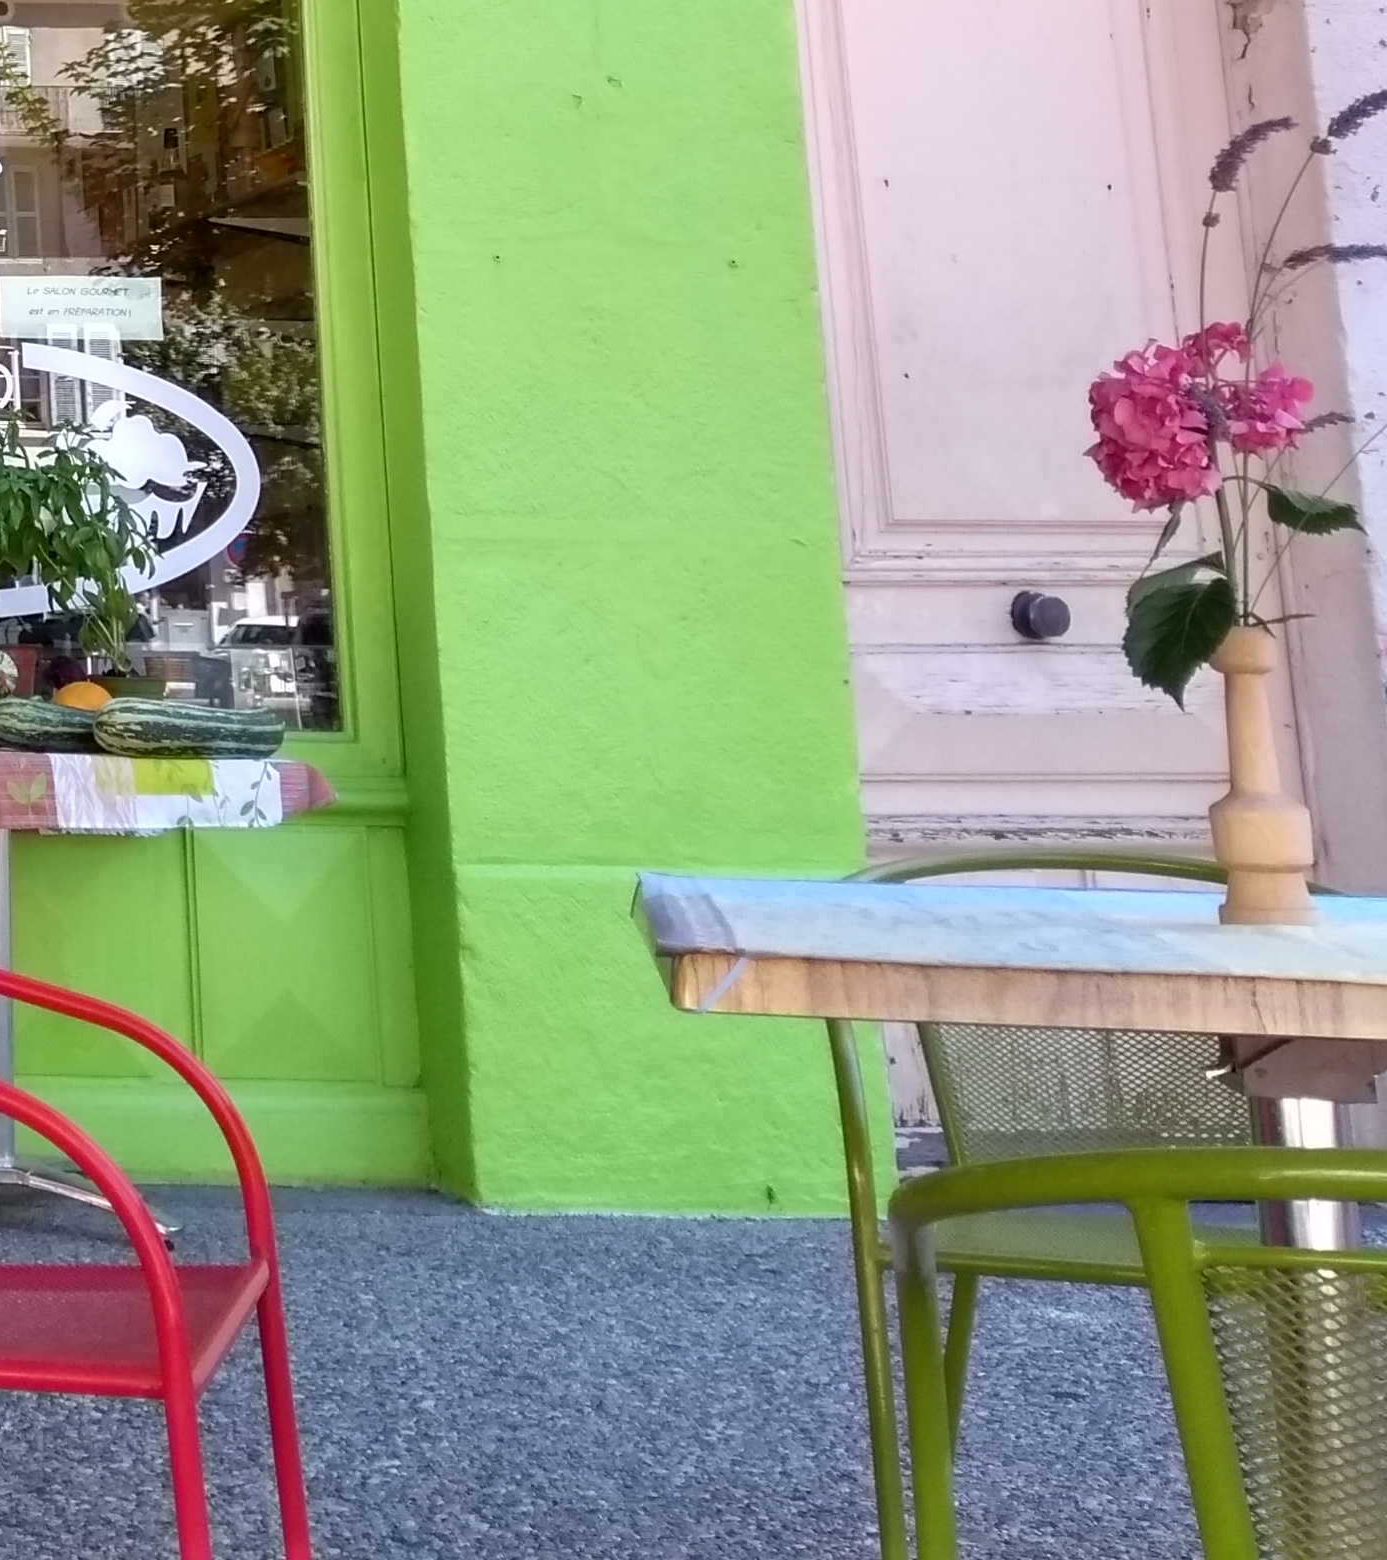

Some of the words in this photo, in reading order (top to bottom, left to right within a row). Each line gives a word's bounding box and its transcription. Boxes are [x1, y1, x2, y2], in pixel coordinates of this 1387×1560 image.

[43, 286, 76, 295] SALON
[81, 287, 130, 296] GOURMET
[29, 307, 44, 315] est
